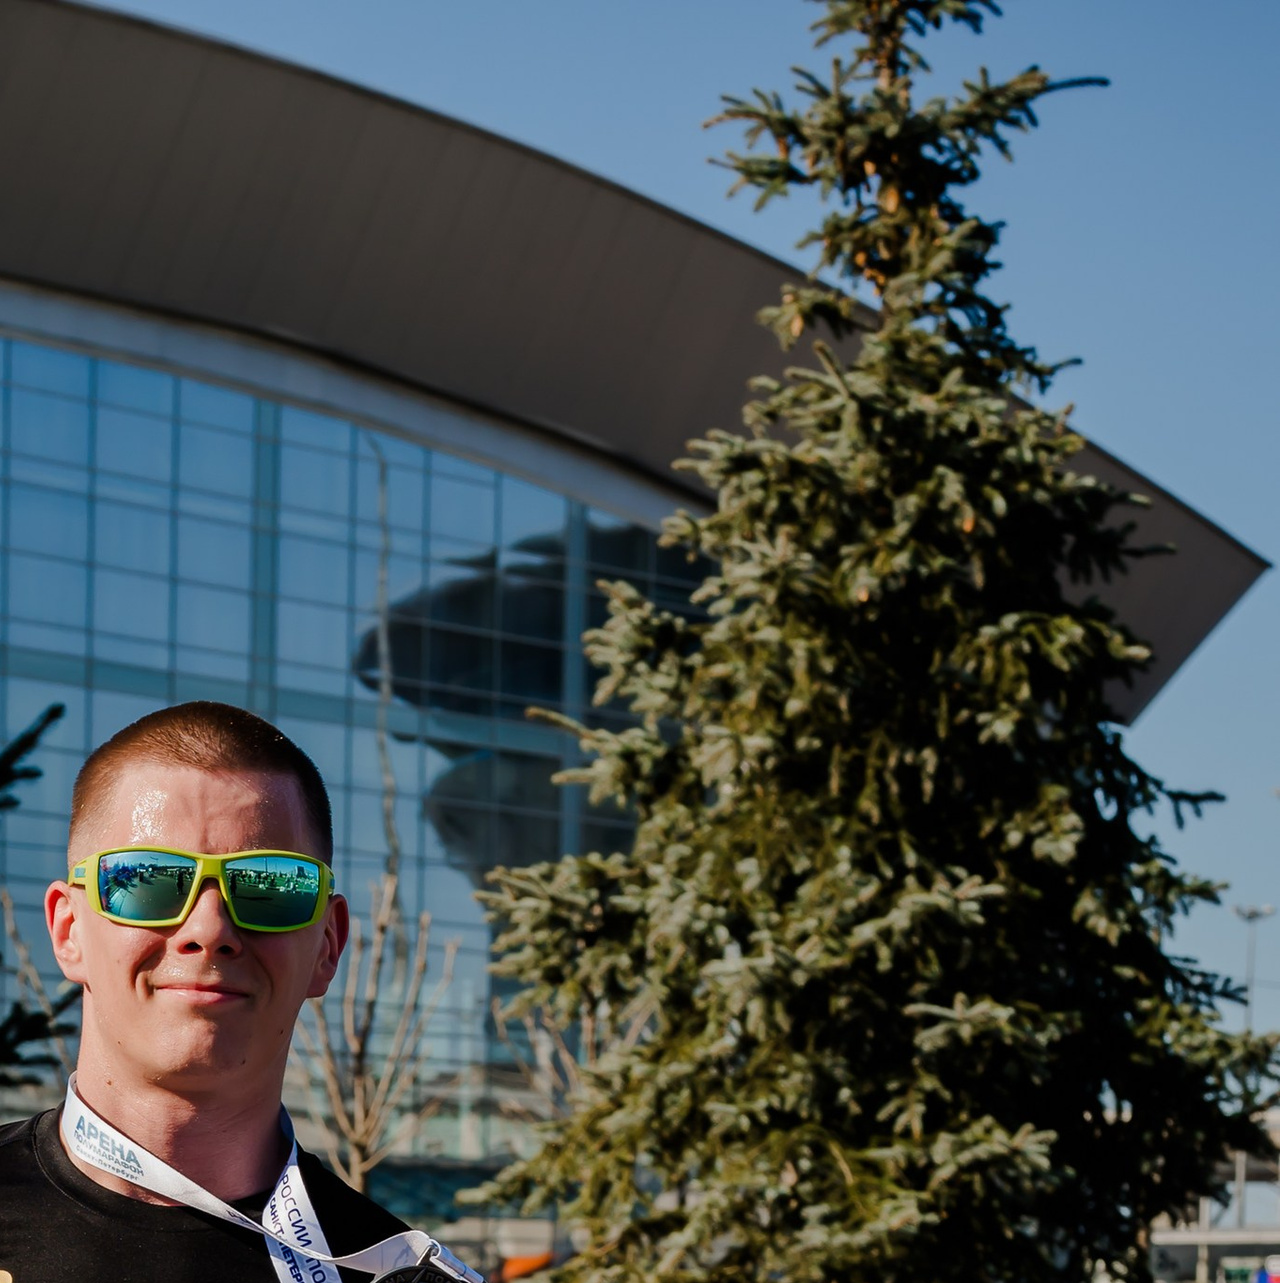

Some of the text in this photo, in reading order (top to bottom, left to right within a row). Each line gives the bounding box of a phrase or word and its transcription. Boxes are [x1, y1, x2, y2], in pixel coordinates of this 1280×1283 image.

[74, 1130, 145, 1177] ПОЛУМАРАФОН
[76, 1115, 142, 1169] АРЕНА
[280, 1173, 313, 1248] РОССИИ
